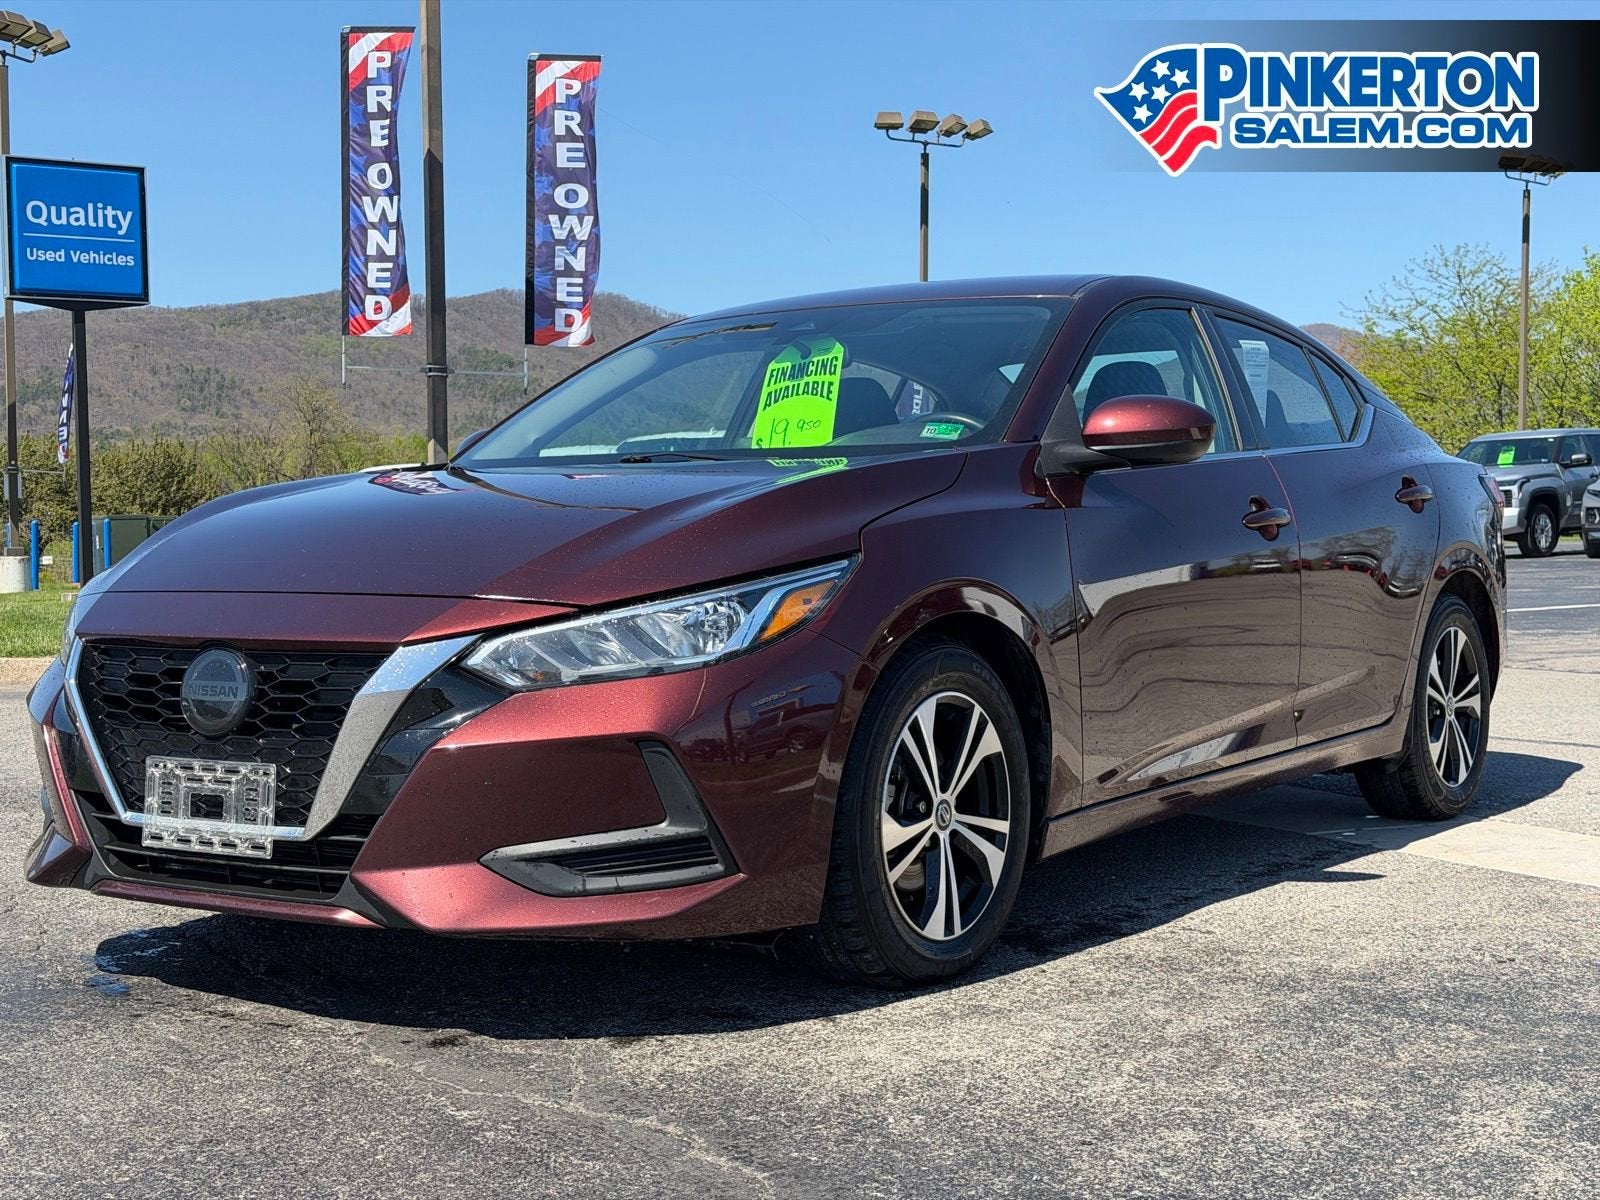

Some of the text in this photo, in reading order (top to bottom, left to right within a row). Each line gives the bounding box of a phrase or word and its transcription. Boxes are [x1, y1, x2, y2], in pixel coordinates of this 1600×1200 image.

[361, 50, 399, 321] PRE OWNED
[25, 200, 133, 236] Quality
[548, 78, 594, 333] PRE OWNED
[26, 247, 135, 267] Used Vehicles
[767, 355, 839, 388] FINANCING
[762, 380, 835, 412] AVAILABLE
[190, 683, 239, 699] NISSAN
